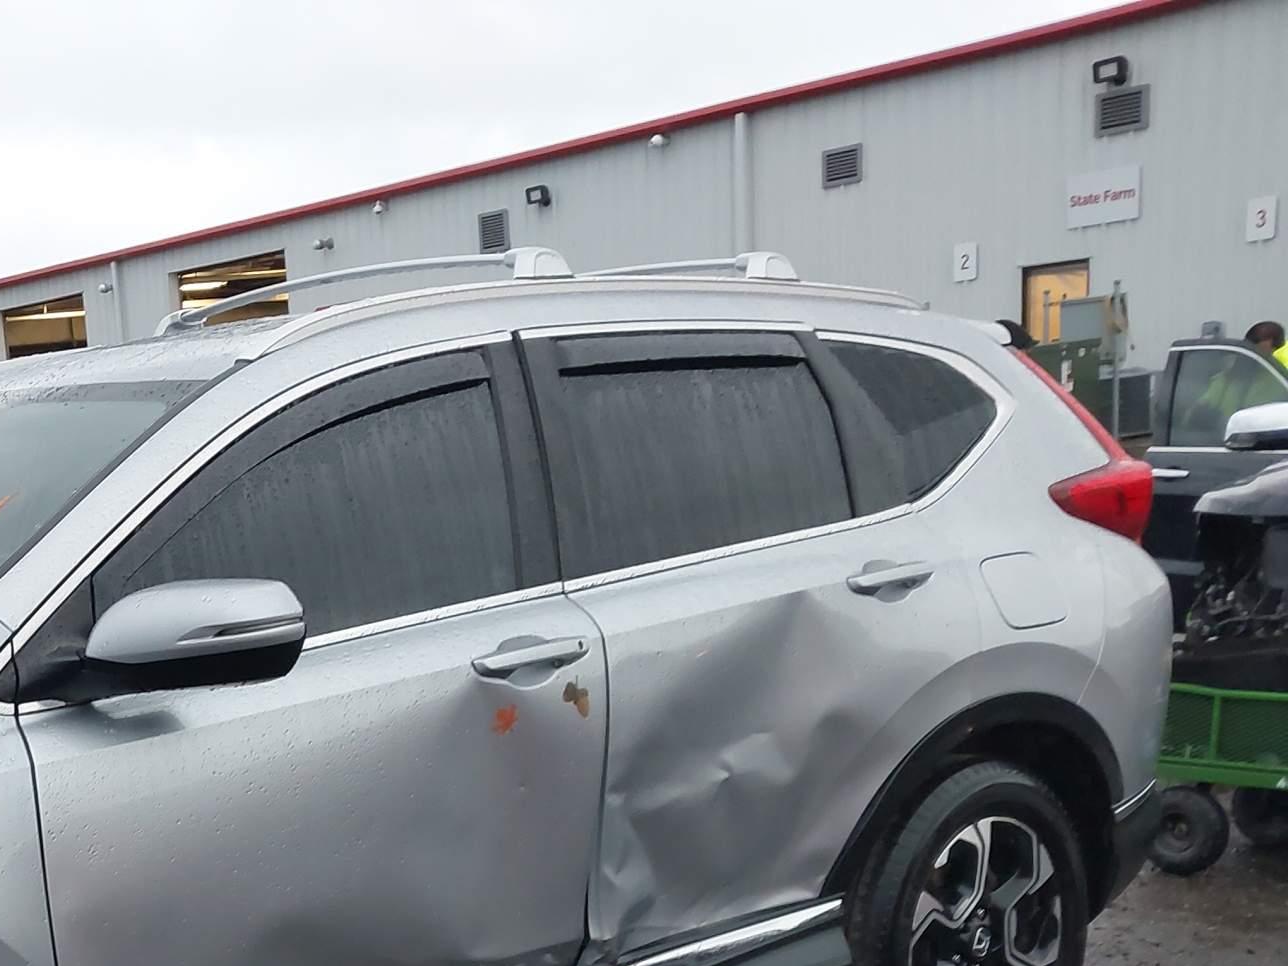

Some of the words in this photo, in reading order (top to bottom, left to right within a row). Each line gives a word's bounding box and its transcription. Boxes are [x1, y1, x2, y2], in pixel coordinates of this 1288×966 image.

[1069, 193, 1102, 208] State
[1103, 188, 1137, 202] Farm
[1255, 209, 1268, 229] 3
[960, 253, 970, 270] 2
